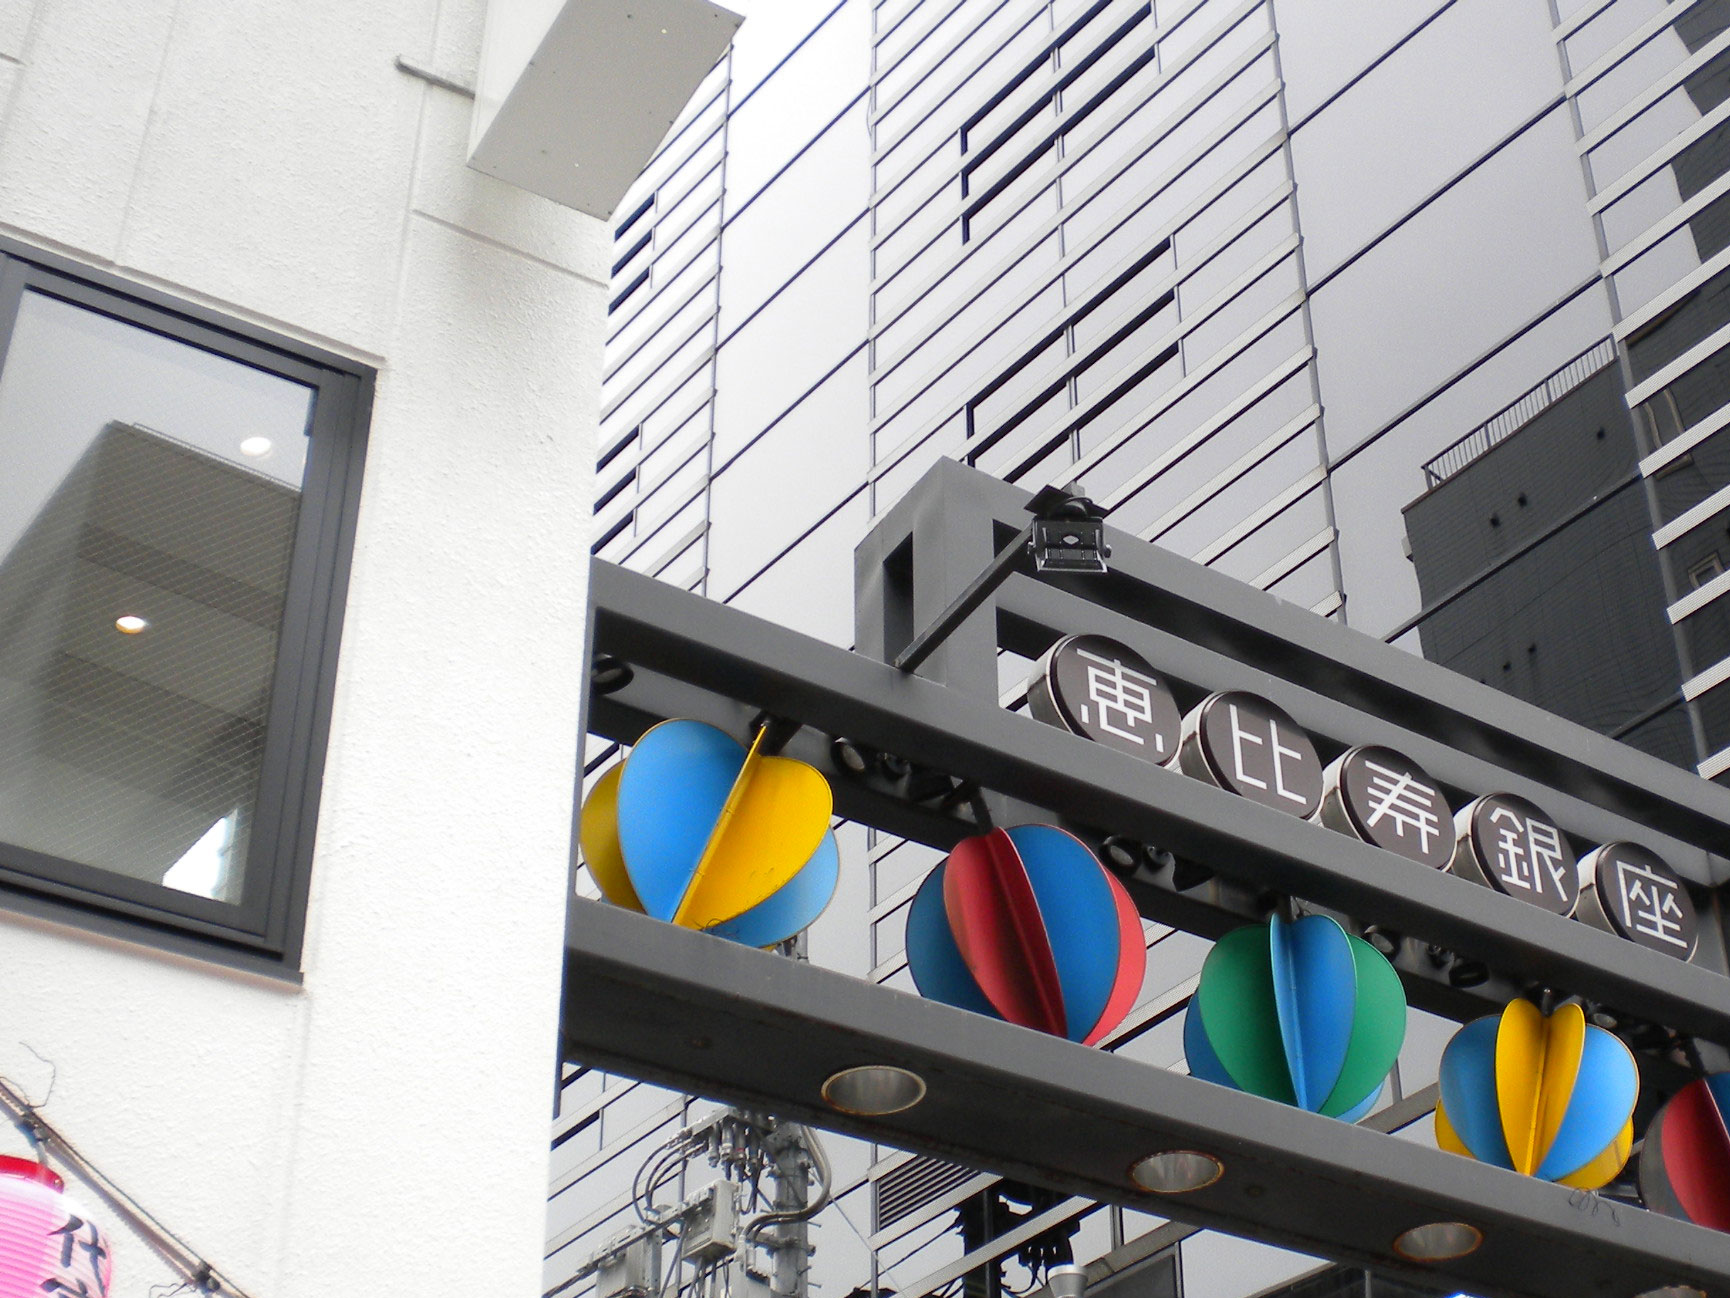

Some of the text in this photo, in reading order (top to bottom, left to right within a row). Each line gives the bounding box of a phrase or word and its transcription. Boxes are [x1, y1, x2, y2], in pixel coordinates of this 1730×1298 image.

[1078, 648, 1688, 948] 恵比寿銀座
